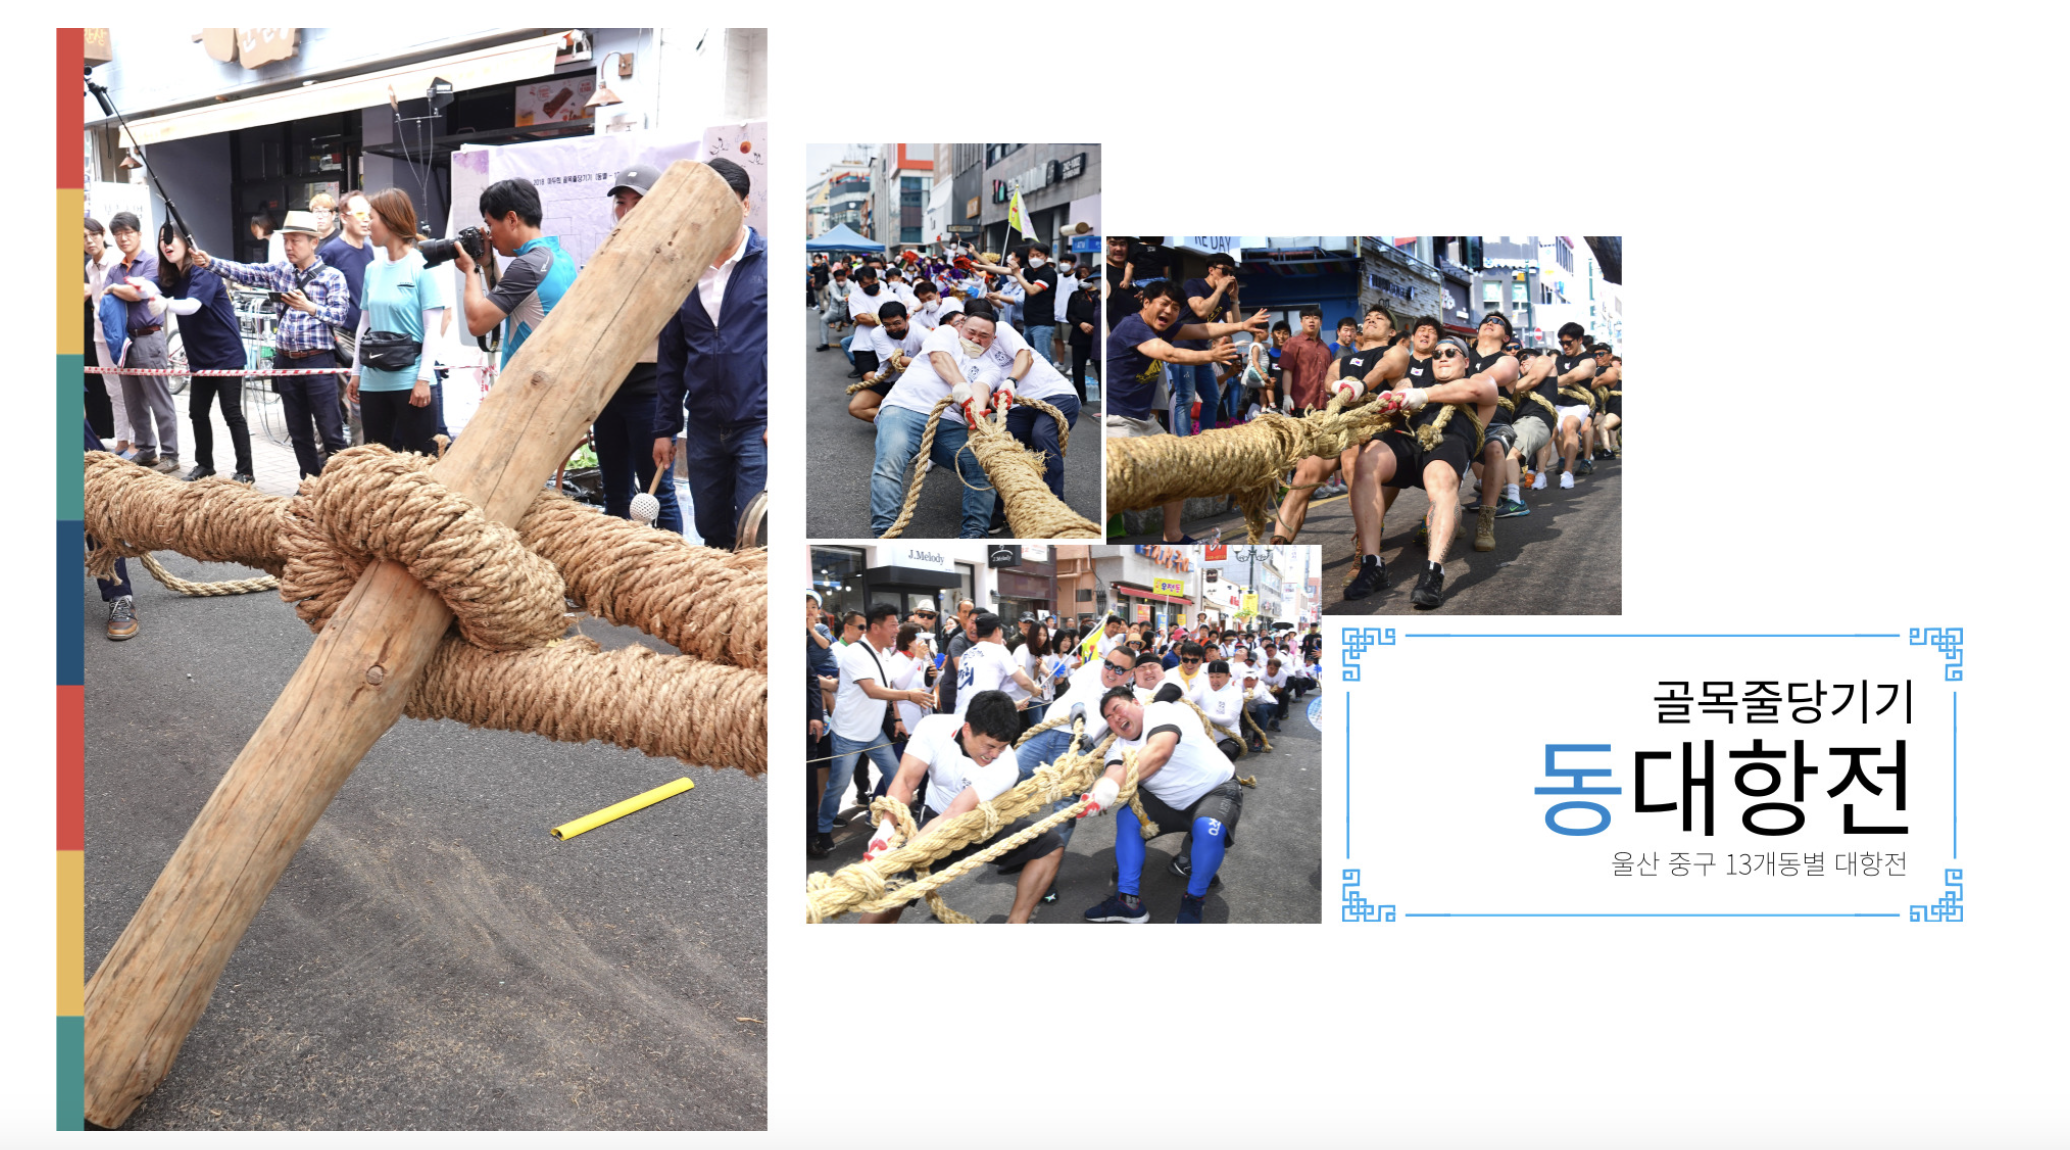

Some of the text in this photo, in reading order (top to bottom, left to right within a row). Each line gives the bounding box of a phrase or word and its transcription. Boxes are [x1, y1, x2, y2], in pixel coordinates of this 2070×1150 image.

[563, 174, 593, 184] 골목줄당기기
[1210, 236, 1231, 254] DAY
[908, 549, 945, 565] J.Melody
[1161, 582, 1181, 594] 우정동
